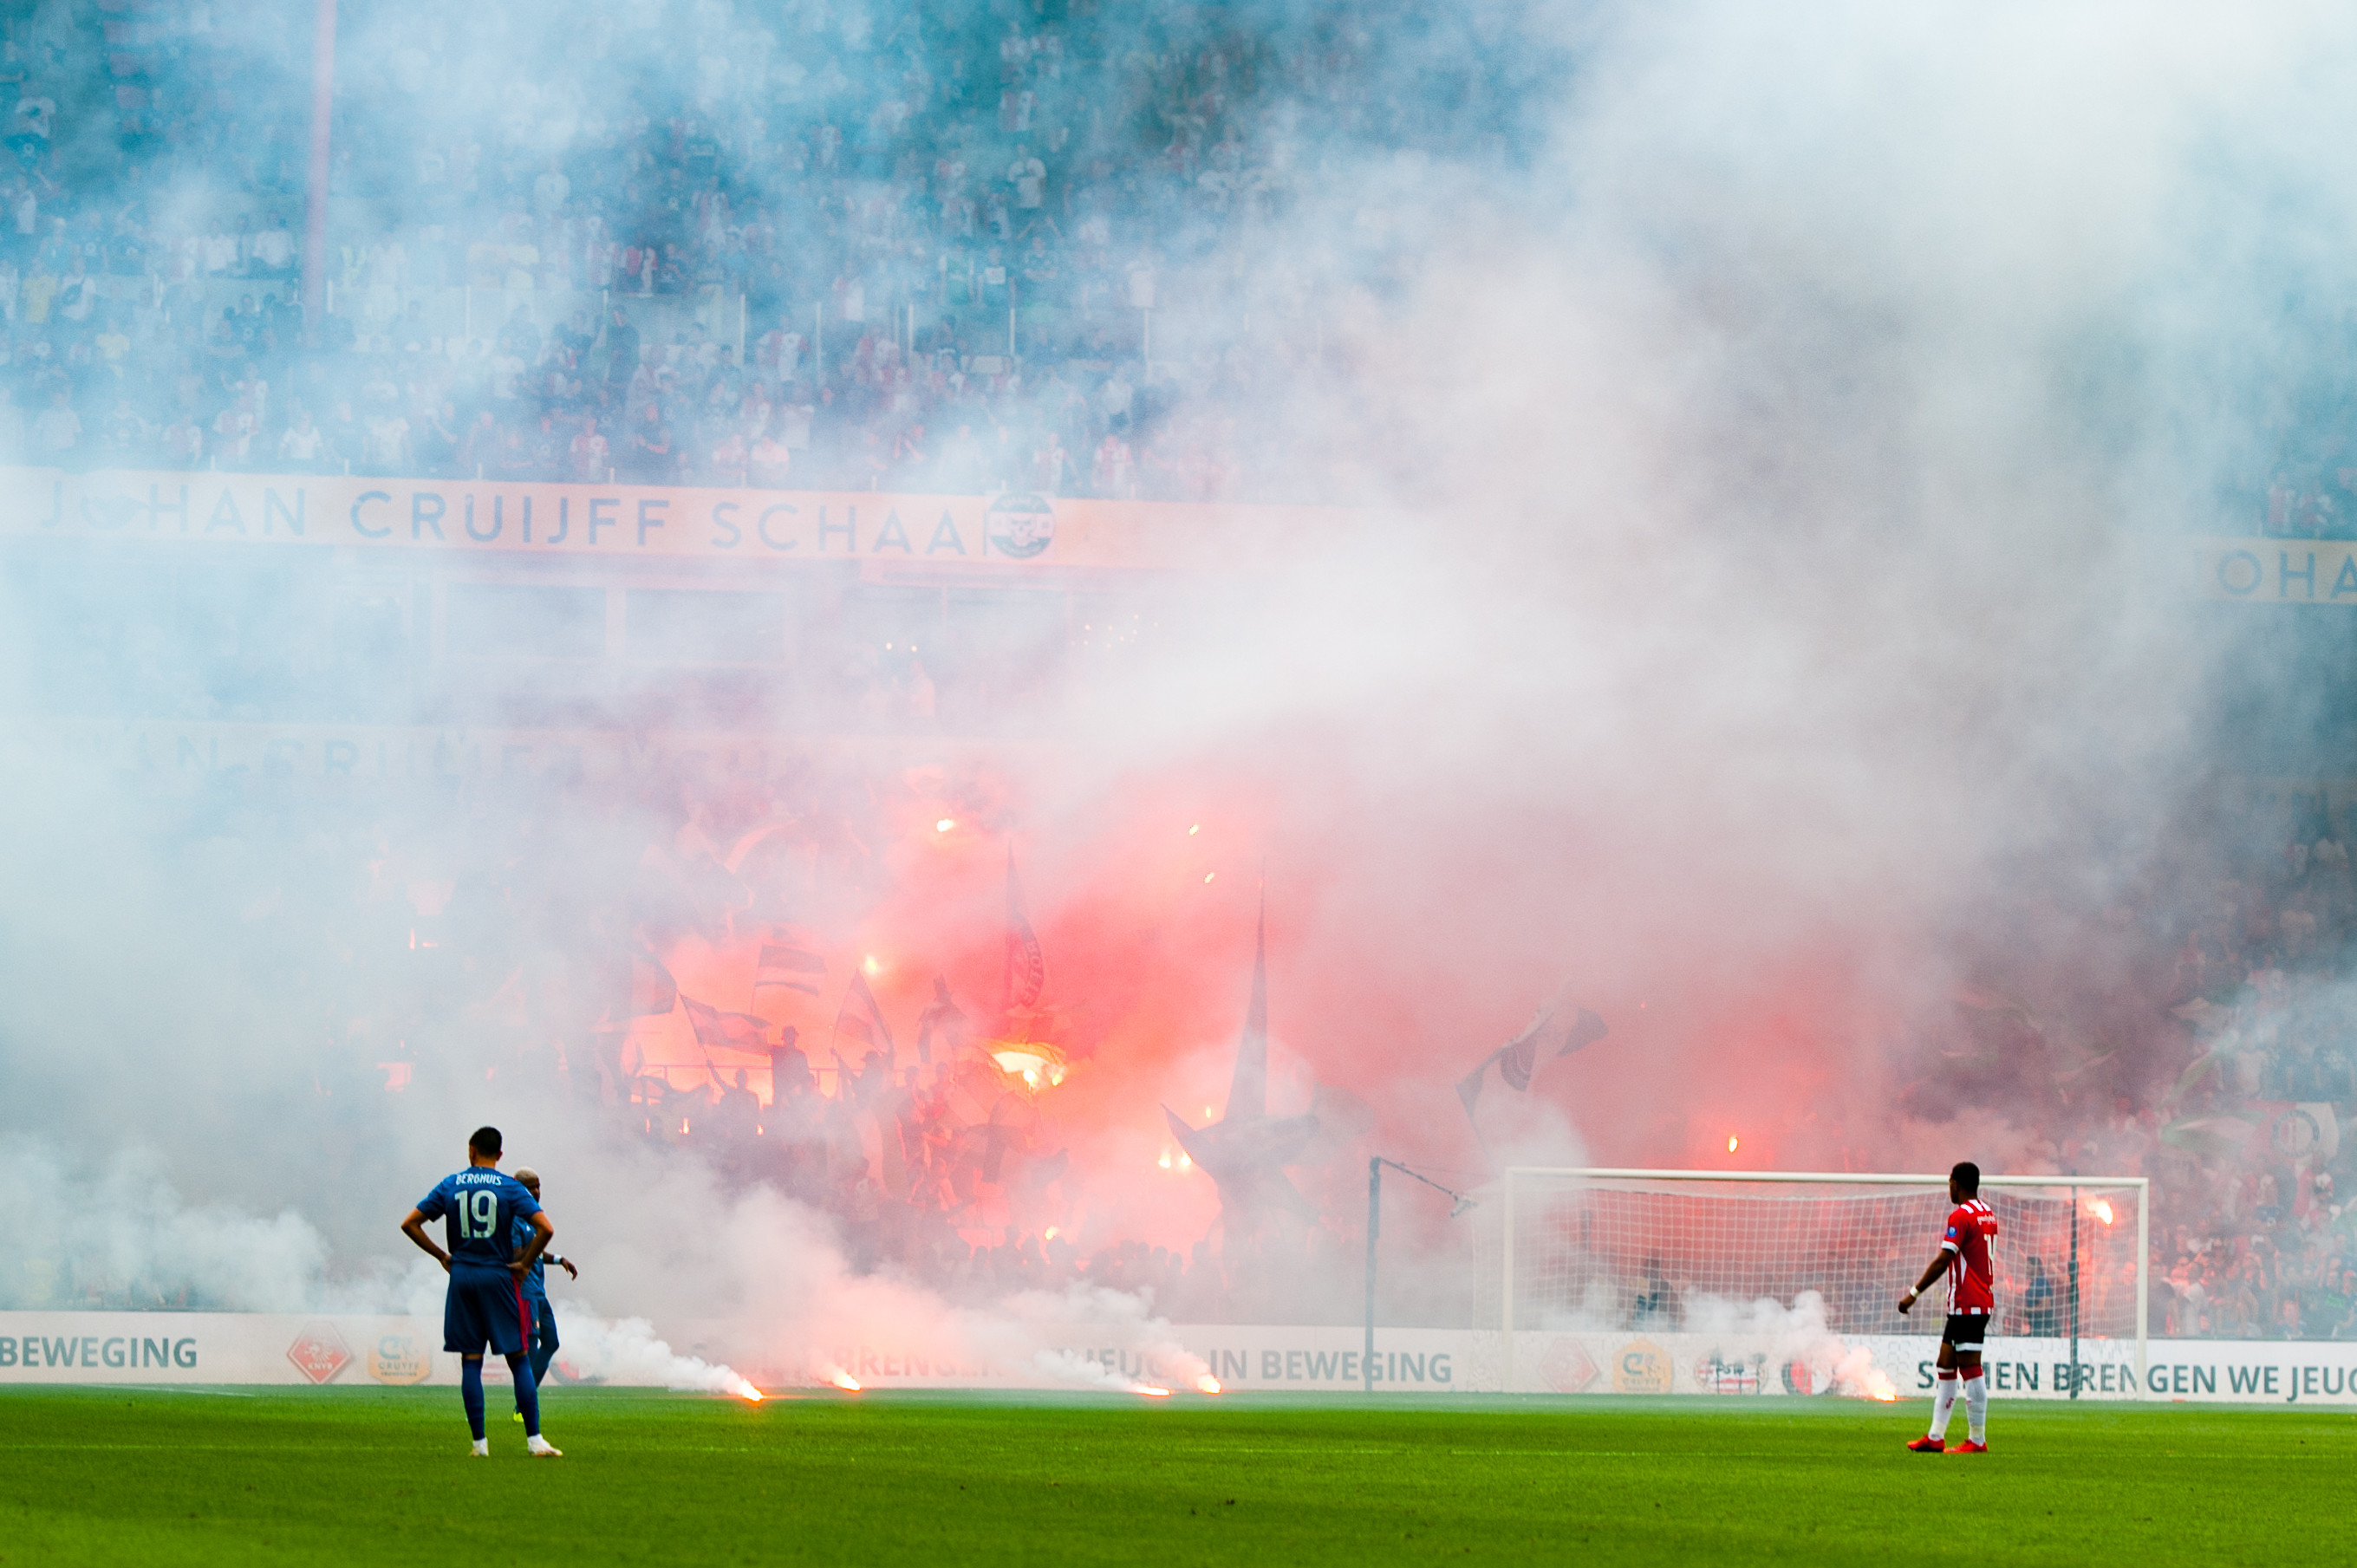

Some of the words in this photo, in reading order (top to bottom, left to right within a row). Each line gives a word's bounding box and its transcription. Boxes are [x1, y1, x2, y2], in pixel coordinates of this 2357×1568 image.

[349, 490, 670, 546] CRUIJFF
[2191, 548, 2357, 599] OHA
[455, 1173, 502, 1186] BERGHUIS
[454, 1189, 498, 1239] 19
[0, 1336, 198, 1369] BEWEGING
[1210, 1349, 1247, 1379] IN
[1262, 1350, 1451, 1383] BEWEGING
[1918, 1361, 2038, 1390] SEN
[2053, 1363, 2216, 1395] BRENGEN
[2228, 1365, 2279, 1394] WE
